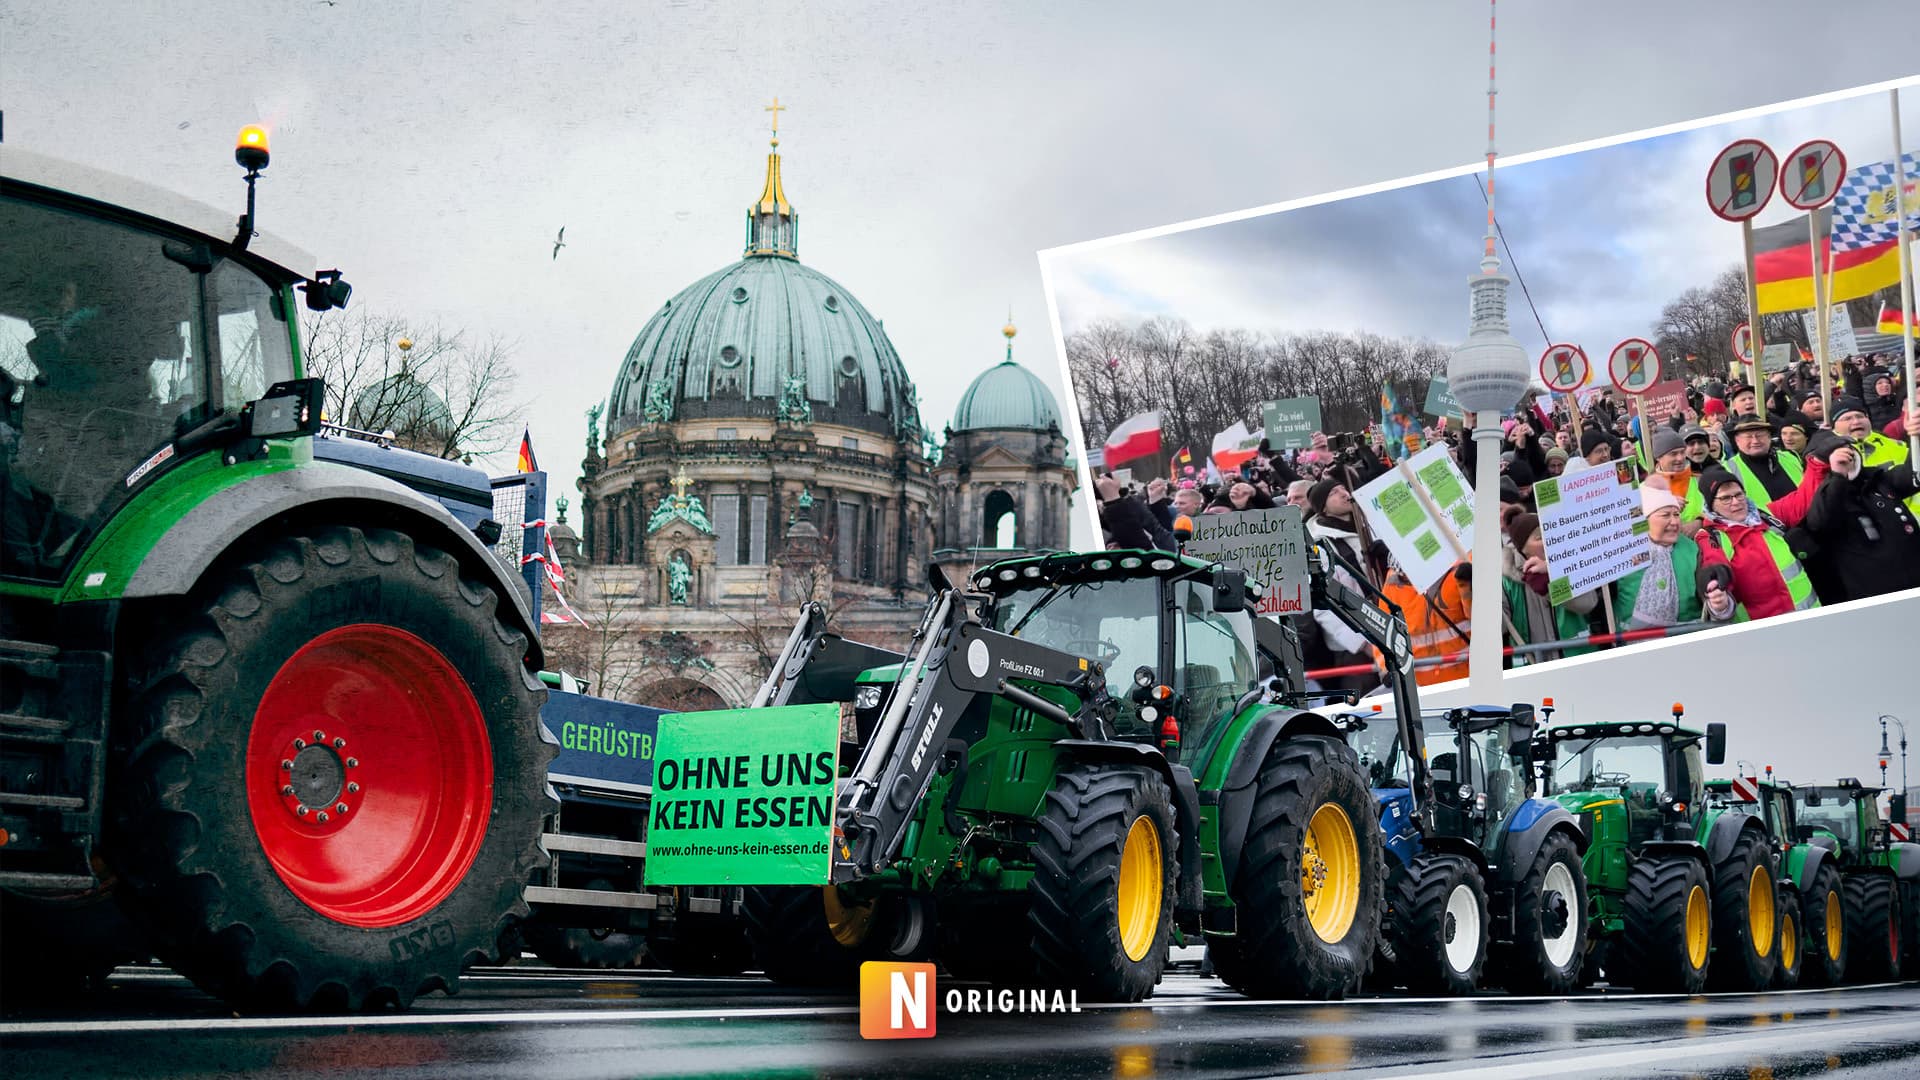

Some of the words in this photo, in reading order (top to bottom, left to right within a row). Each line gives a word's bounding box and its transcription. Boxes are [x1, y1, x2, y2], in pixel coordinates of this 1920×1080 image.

[1273, 424, 1282, 433] ist
[1294, 421, 1311, 431] viel!
[1278, 413, 1289, 422] Zu
[1289, 410, 1304, 420] viel
[1563, 469, 1616, 492] LANDFRAUEN
[1575, 494, 1584, 503] in
[1584, 487, 1610, 501] Aktion
[1542, 521, 1558, 531] Die
[1559, 511, 1589, 527] Bauern
[1589, 501, 1616, 517] sorgen
[1616, 496, 1632, 508] sich
[1545, 533, 1565, 547] über
[1567, 529, 1581, 540] die
[1581, 518, 1612, 535] Zukunft
[1613, 513, 1632, 525] ihrer
[1548, 548, 1579, 564] Kinder,
[1580, 539, 1600, 553] wollt
[1613, 528, 1633, 540] diese
[1563, 564, 1578, 575] mit
[1579, 555, 1603, 568] Euren
[1603, 536, 1649, 560] Sparpaketen
[1255, 584, 1303, 614] schland
[1000, 658, 1024, 673] ProfiLine
[1024, 664, 1033, 676] FZ
[562, 721, 653, 760] GERÜSTB
[911, 702, 944, 773] STOLL
[658, 755, 750, 791] OHNE
[760, 751, 834, 787] UNS
[654, 799, 725, 831] KEIN
[734, 795, 833, 829] ESSEN
[652, 841, 829, 857] www.ohne-uns-kein-essen.de
